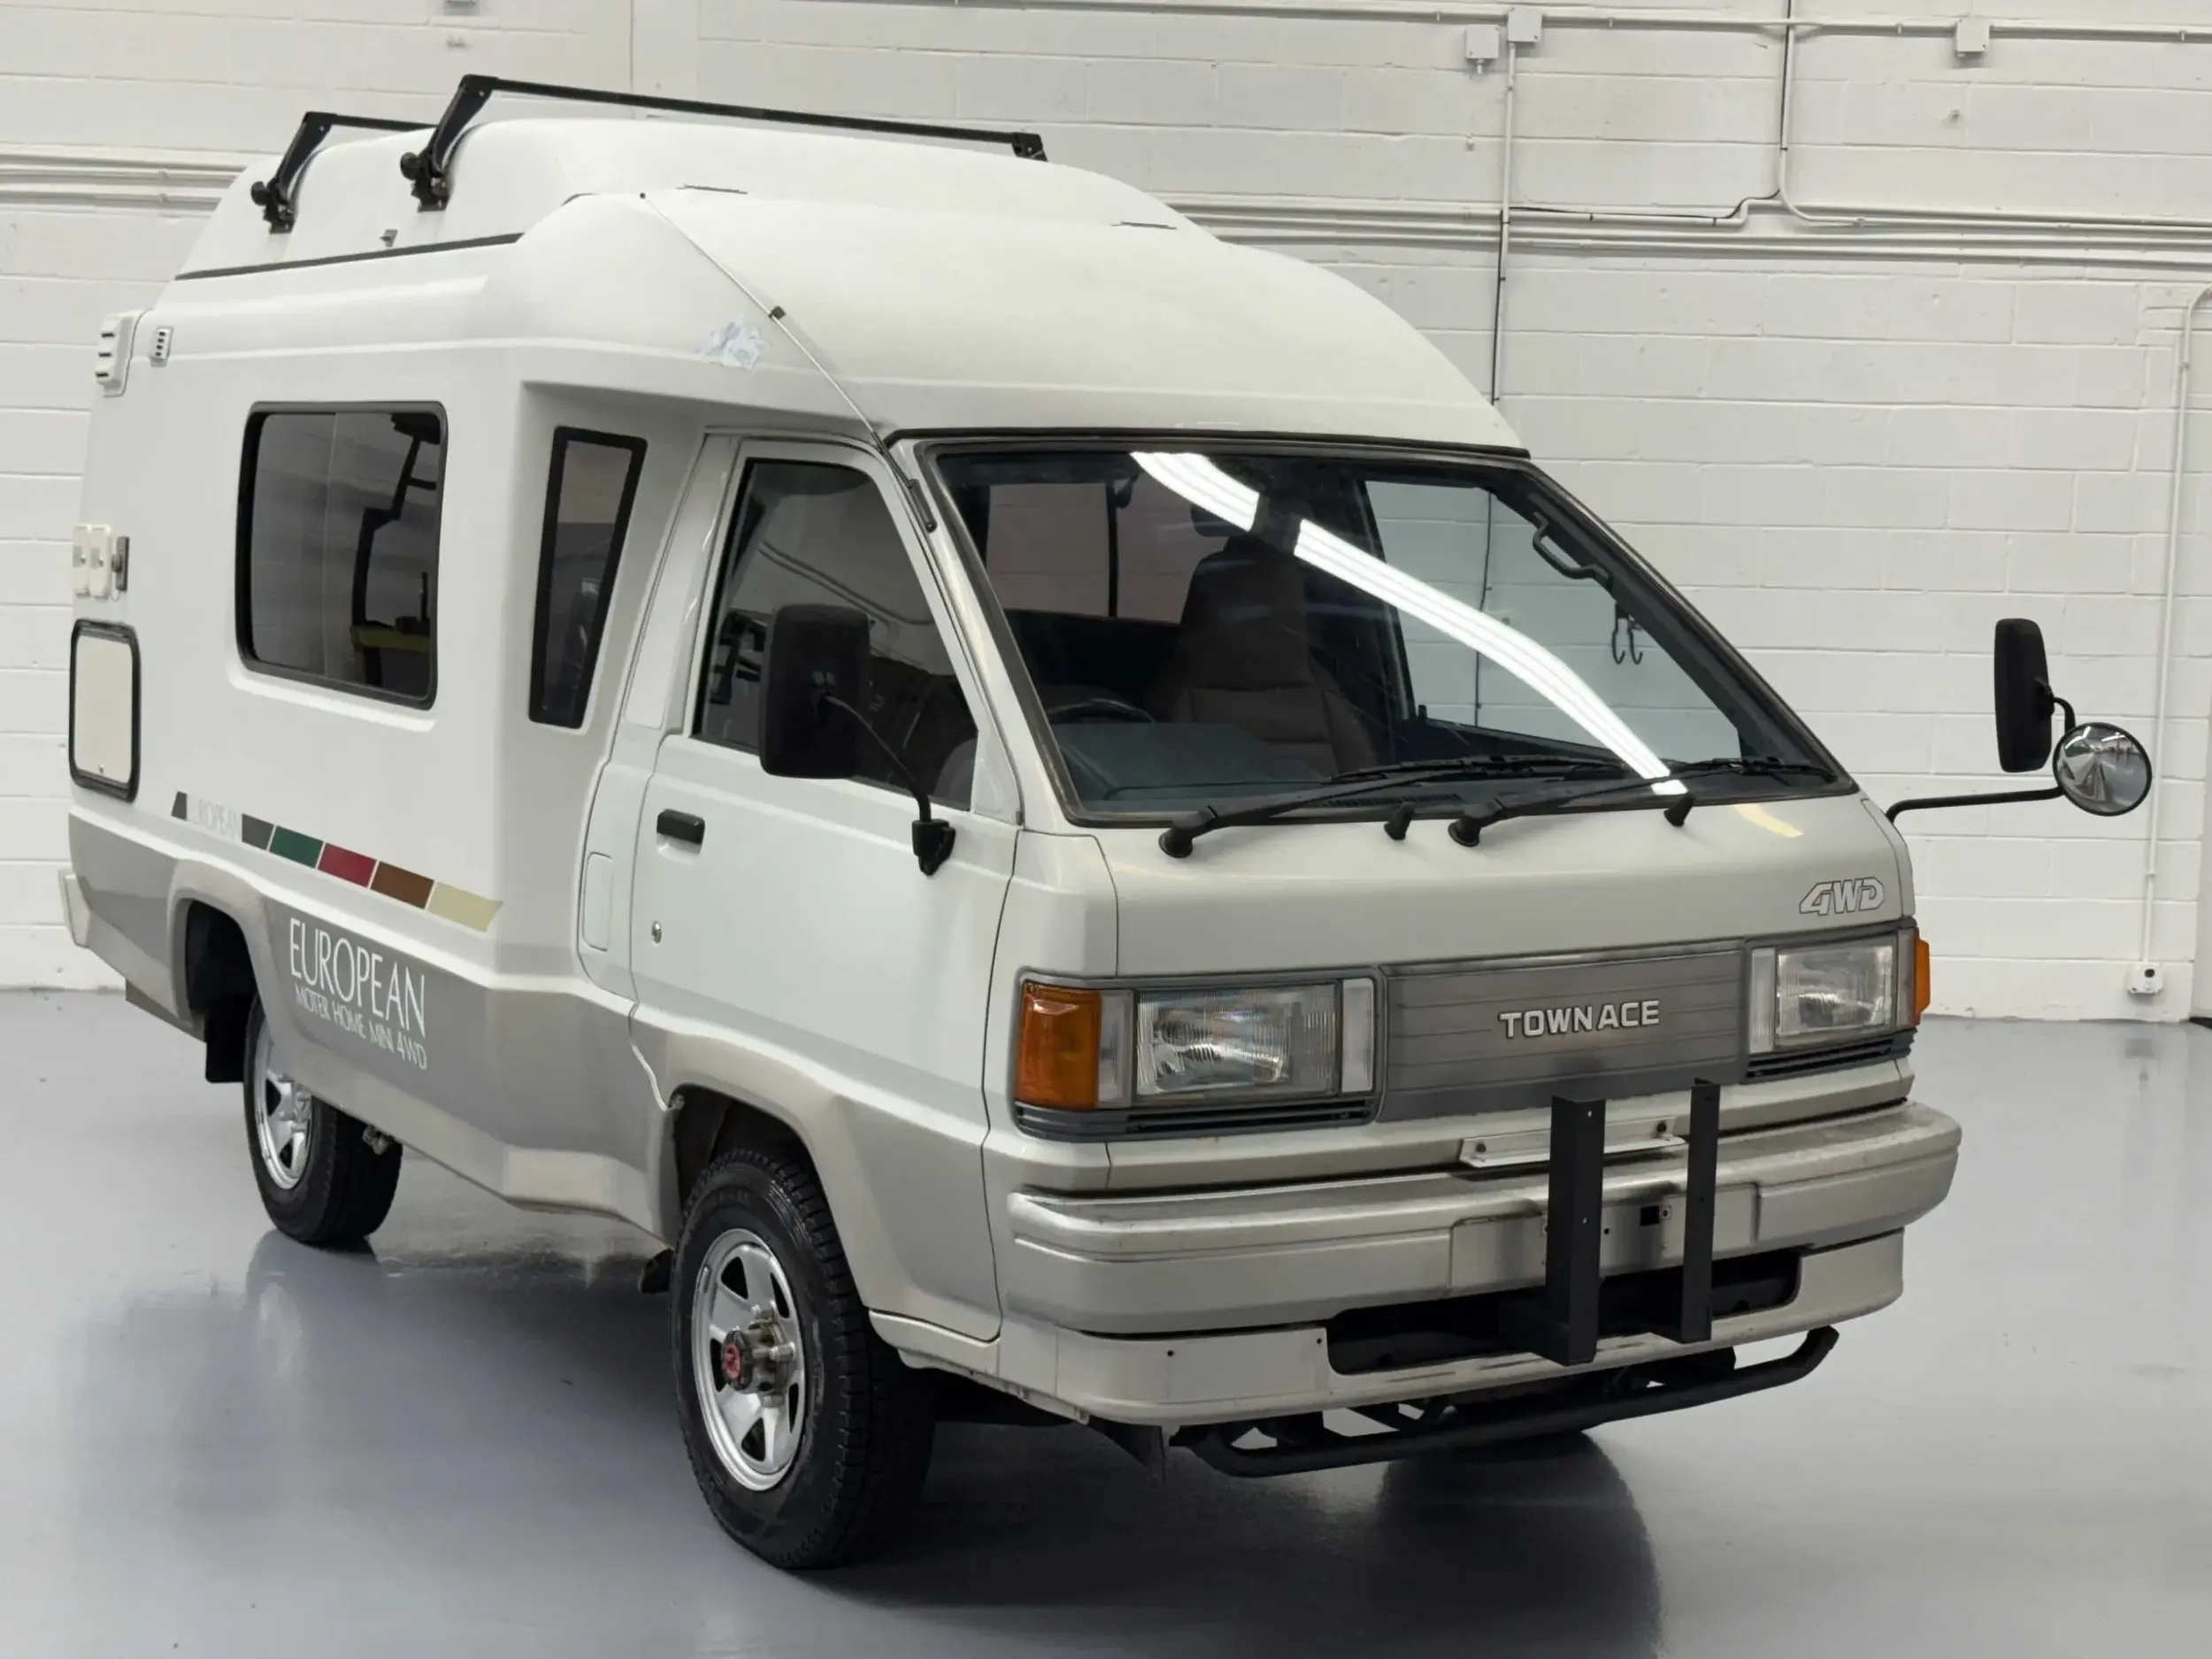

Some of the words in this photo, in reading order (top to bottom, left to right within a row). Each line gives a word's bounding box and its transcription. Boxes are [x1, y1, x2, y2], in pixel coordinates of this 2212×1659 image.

[1799, 876, 1885, 917] 4WD
[289, 918, 426, 1039] EUROPEAN
[332, 1000, 366, 1040] HOME
[396, 1030, 427, 1070] 4WD
